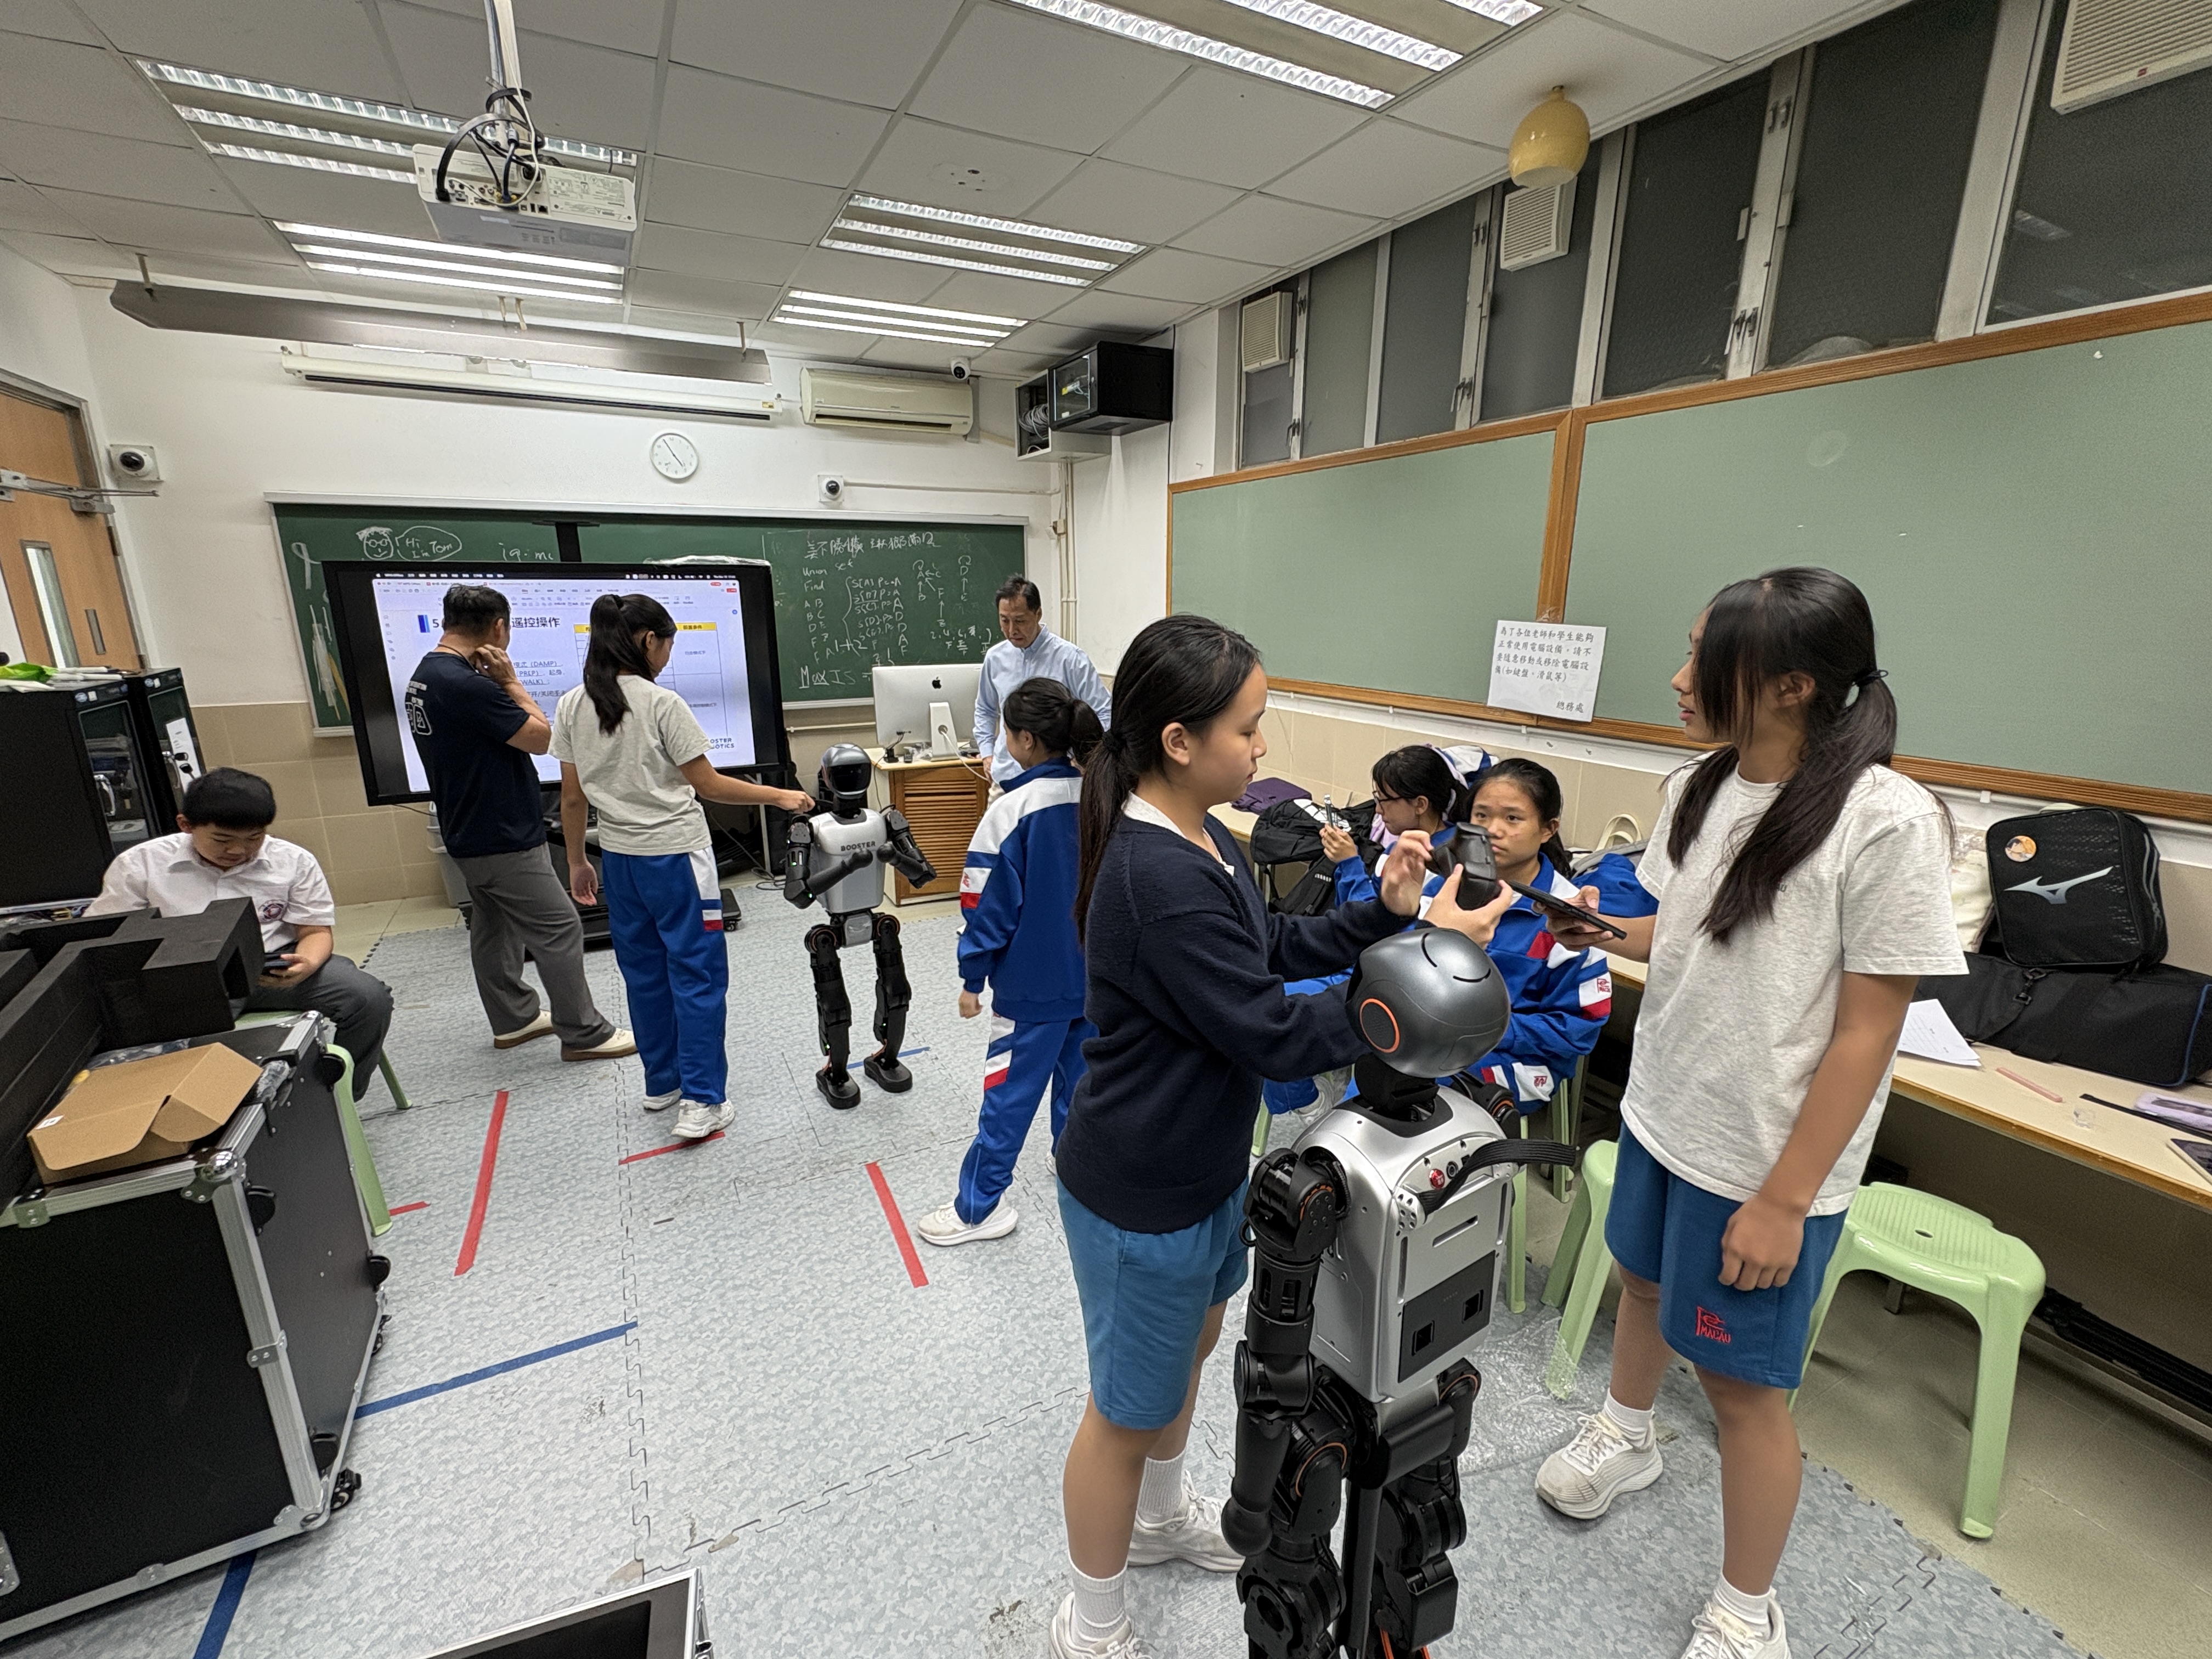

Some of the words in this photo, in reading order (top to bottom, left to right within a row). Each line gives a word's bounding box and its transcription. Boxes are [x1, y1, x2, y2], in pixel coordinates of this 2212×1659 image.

[406, 538, 420, 549] Hi
[429, 540, 453, 554] Tom
[804, 579, 825, 592] Find
[511, 617, 561, 628] 遥控操作
[840, 841, 876, 851] BOOSTER
[1700, 1325, 1731, 1344] MACAU
